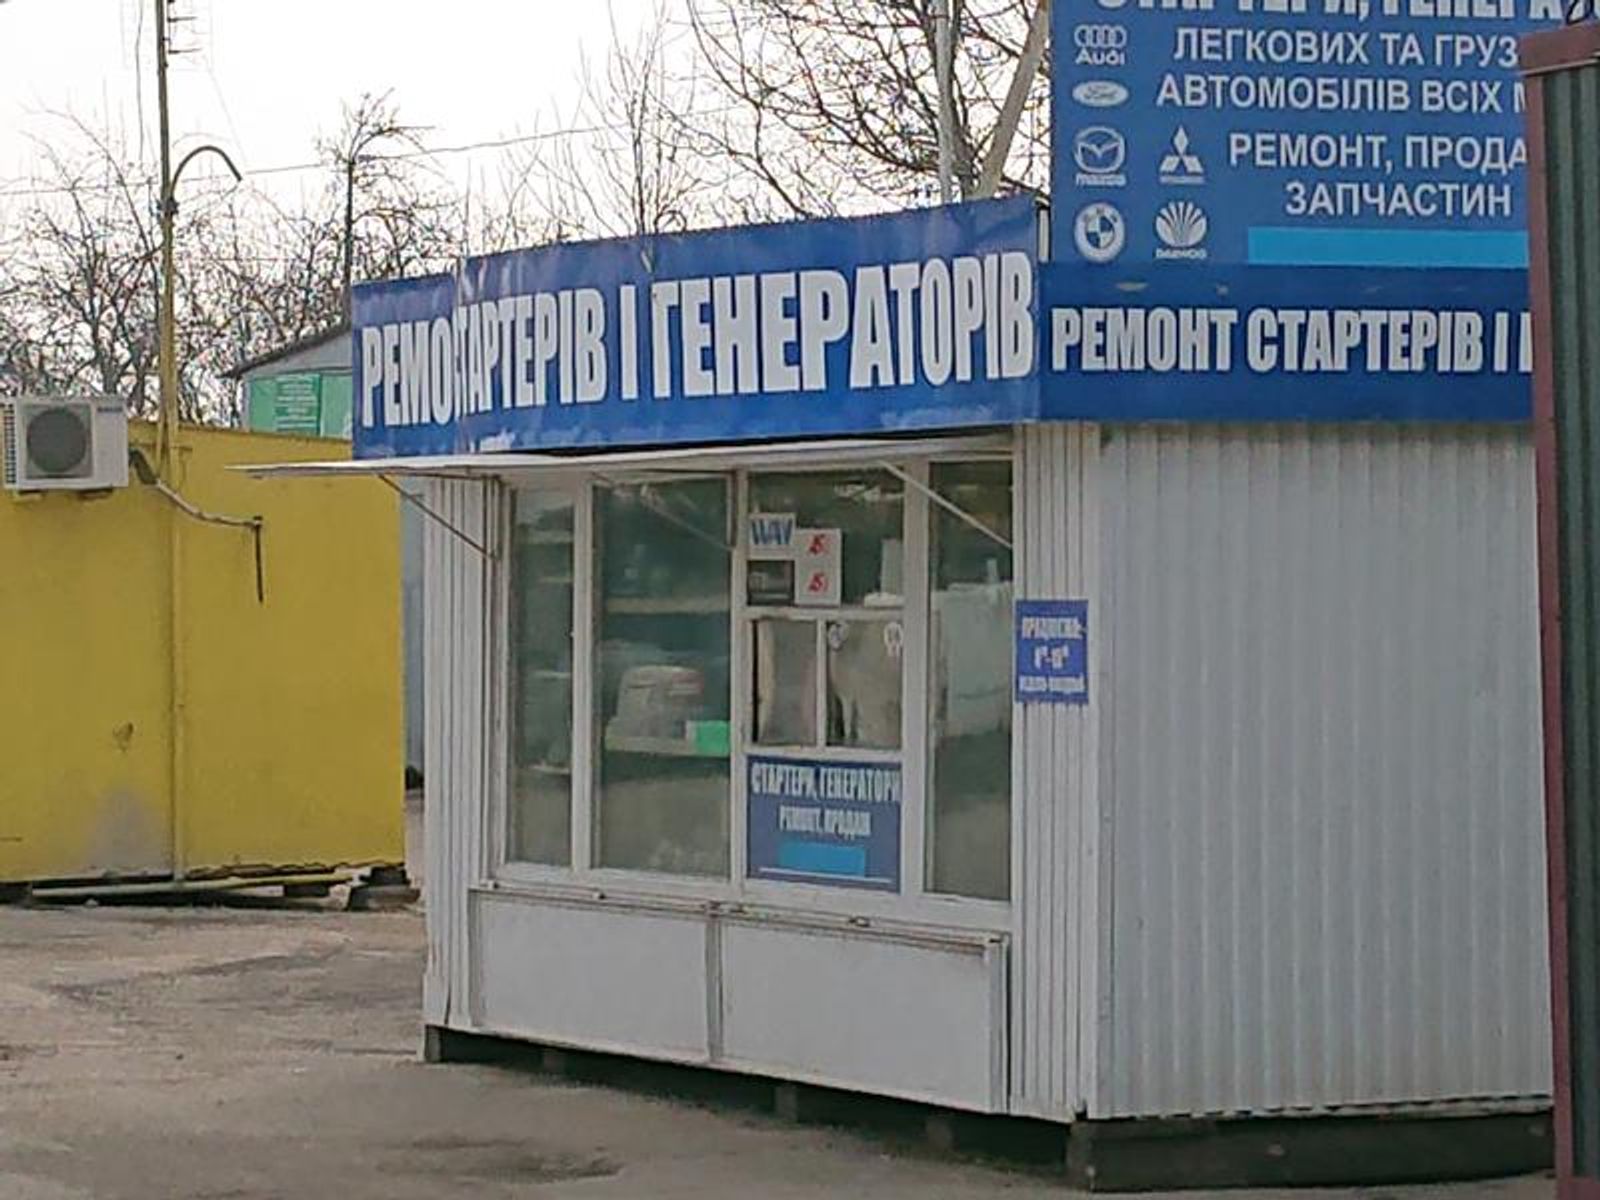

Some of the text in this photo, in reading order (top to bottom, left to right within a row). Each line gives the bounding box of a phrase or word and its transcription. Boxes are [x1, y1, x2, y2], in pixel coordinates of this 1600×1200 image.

[1075, 47, 1126, 65] Audi
[1173, 27, 1519, 67] ЛЕГКОВИХ ТА ГРУЗ
[1156, 72, 1411, 112] АВТОМОБІЛІВ
[1422, 79, 1503, 113] ВСІХ
[1229, 133, 1528, 175] РЕМОНТ, ПРОДА
[1286, 181, 1512, 216] ЗАПЧАСТИН
[650, 251, 1034, 399] ГЕНЕРАТОРІВ
[1051, 307, 1239, 372] РЕМОНТ
[1247, 308, 1484, 373] СТАРТЕРІВ
